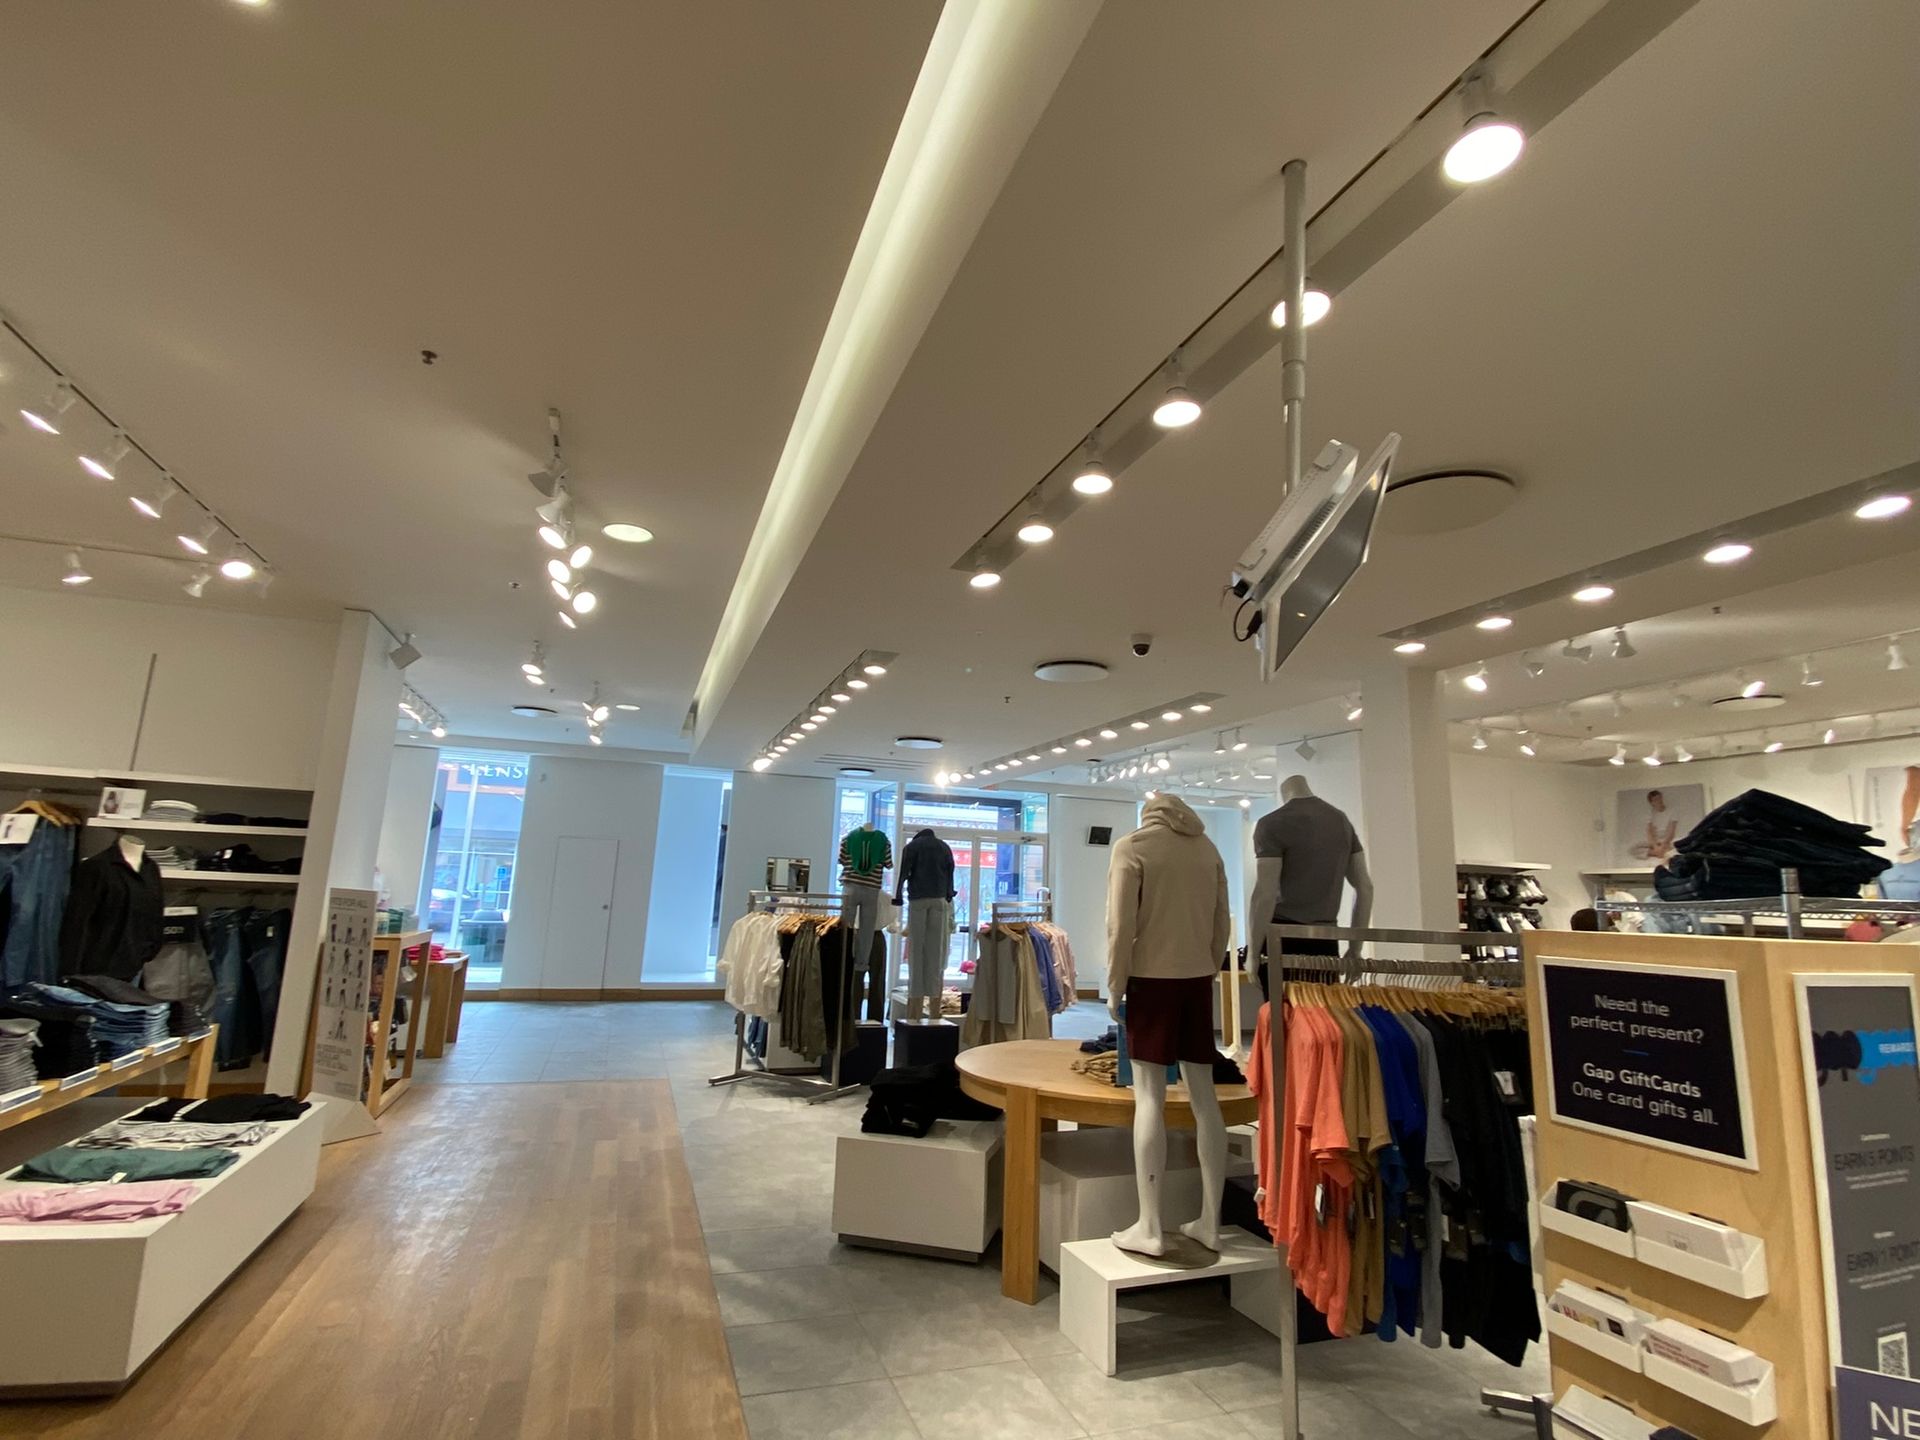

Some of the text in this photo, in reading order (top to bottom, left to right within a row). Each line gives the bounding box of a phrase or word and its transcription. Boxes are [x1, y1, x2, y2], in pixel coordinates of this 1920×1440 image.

[1594, 994, 1670, 1017] Need the
[1570, 1015, 1704, 1043] perfect present?
[1583, 1062, 1701, 1098] Gap GiftCards
[1572, 1081, 1719, 1125] One card gifts all.
